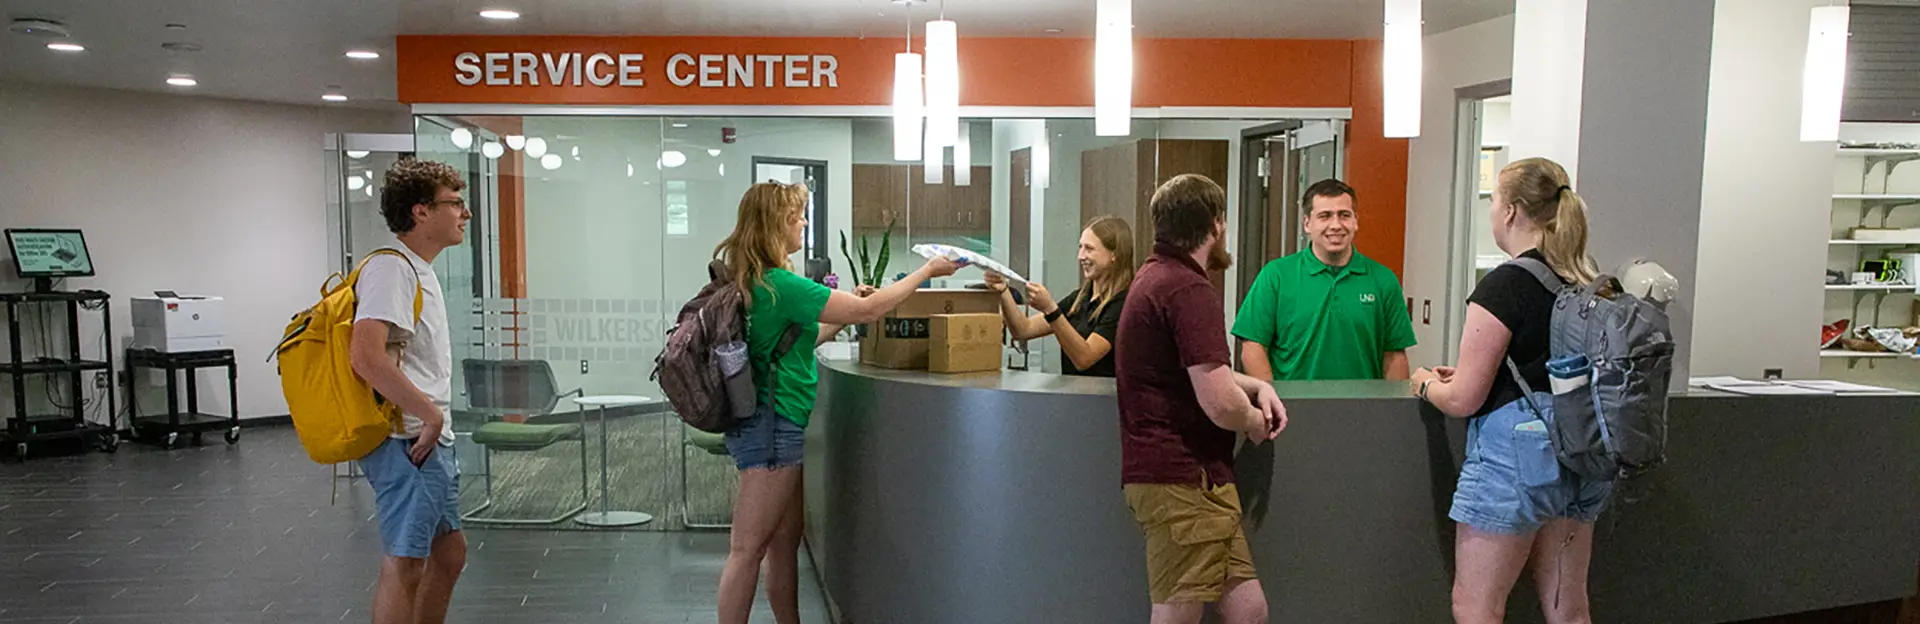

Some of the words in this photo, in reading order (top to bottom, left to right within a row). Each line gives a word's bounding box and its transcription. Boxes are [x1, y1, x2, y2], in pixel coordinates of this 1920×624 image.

[454, 52, 644, 87] SERVICE
[665, 53, 840, 89] CENTER
[554, 318, 672, 343] WILKERSO
